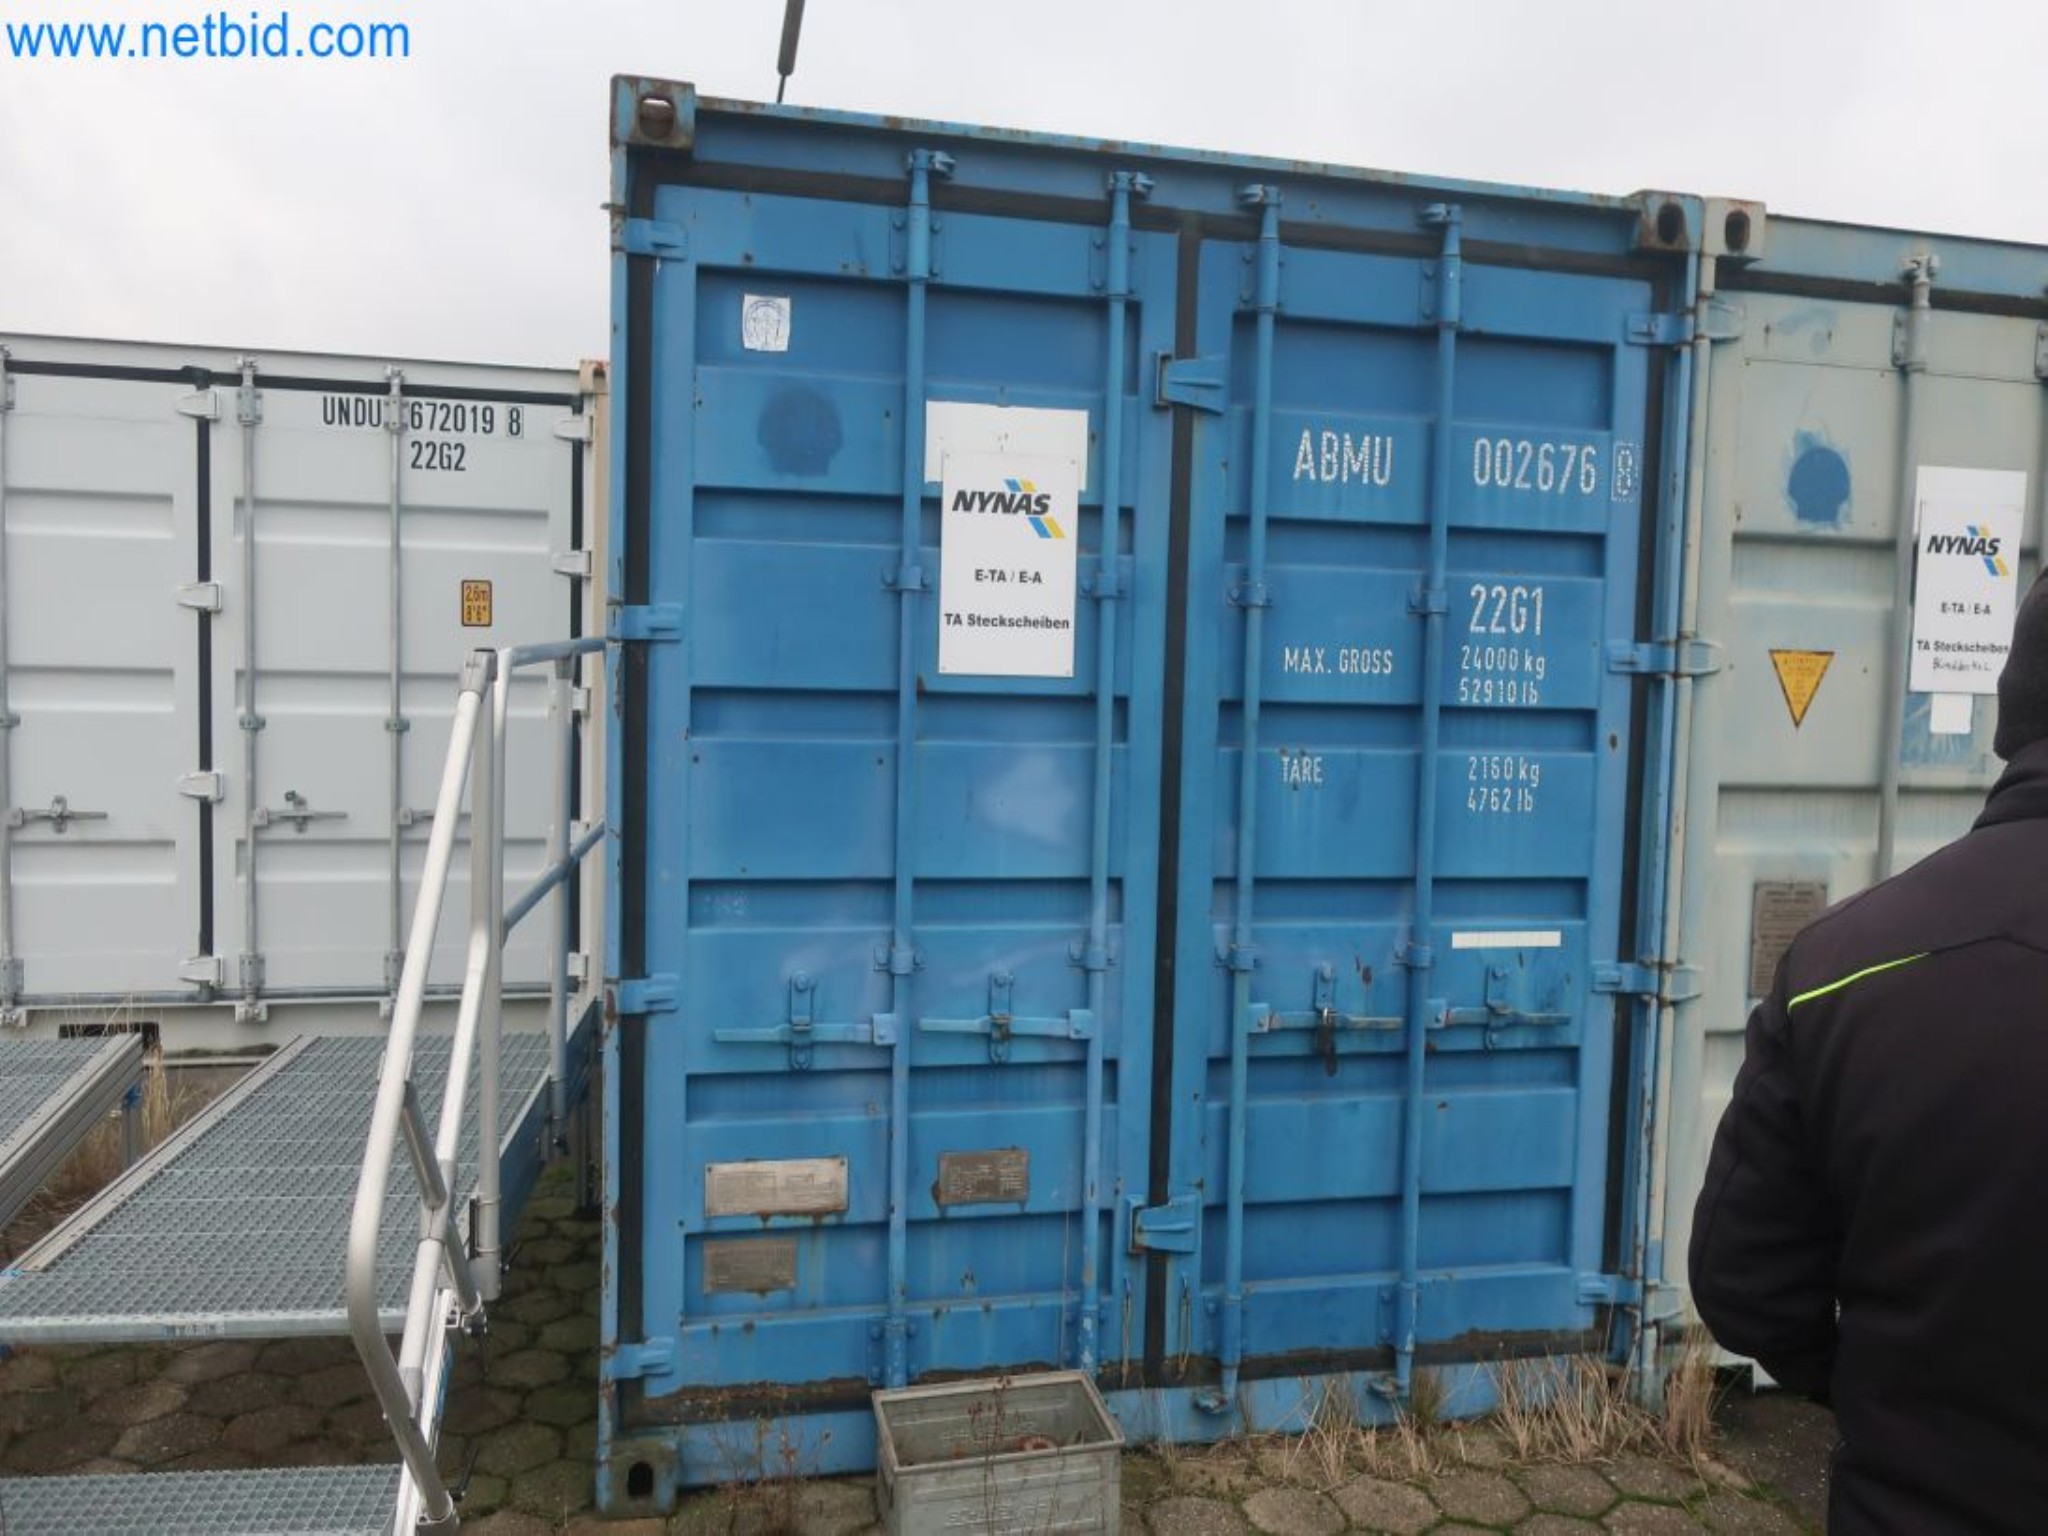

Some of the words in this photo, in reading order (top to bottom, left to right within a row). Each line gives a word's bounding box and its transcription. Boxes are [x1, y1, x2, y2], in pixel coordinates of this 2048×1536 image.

[323, 396, 382, 427] UNDU
[410, 401, 495, 434] 672019
[508, 407, 521, 436] 8
[410, 440, 466, 471] 22G2
[1293, 429, 1393, 486] ABMU
[1473, 437, 1597, 494] 002676
[952, 489, 1051, 516] NYNAS
[1927, 534, 2000, 556] NYNAS
[974, 569, 1007, 583] E-TA
[1019, 570, 1042, 584] E-A
[944, 613, 963, 627] TA
[967, 614, 1070, 630] Steckscheiben
[1469, 584, 1544, 636] 22G1
[1941, 602, 1965, 615] E-TA
[1974, 603, 1991, 615] E-A
[1916, 639, 1931, 651] TA
[1284, 647, 1332, 674] MAX.
[1339, 649, 1393, 675] GROSS
[1461, 645, 1519, 671] 24000
[1525, 648, 1546, 678] kg
[1459, 678, 1517, 704] 52910
[1522, 681, 1538, 705] lb
[1281, 756, 1323, 783] TARE
[1468, 756, 1513, 781] 2160
[1519, 757, 1540, 786] kg
[1467, 788, 1511, 812] 4762
[1517, 788, 1534, 812] lb
